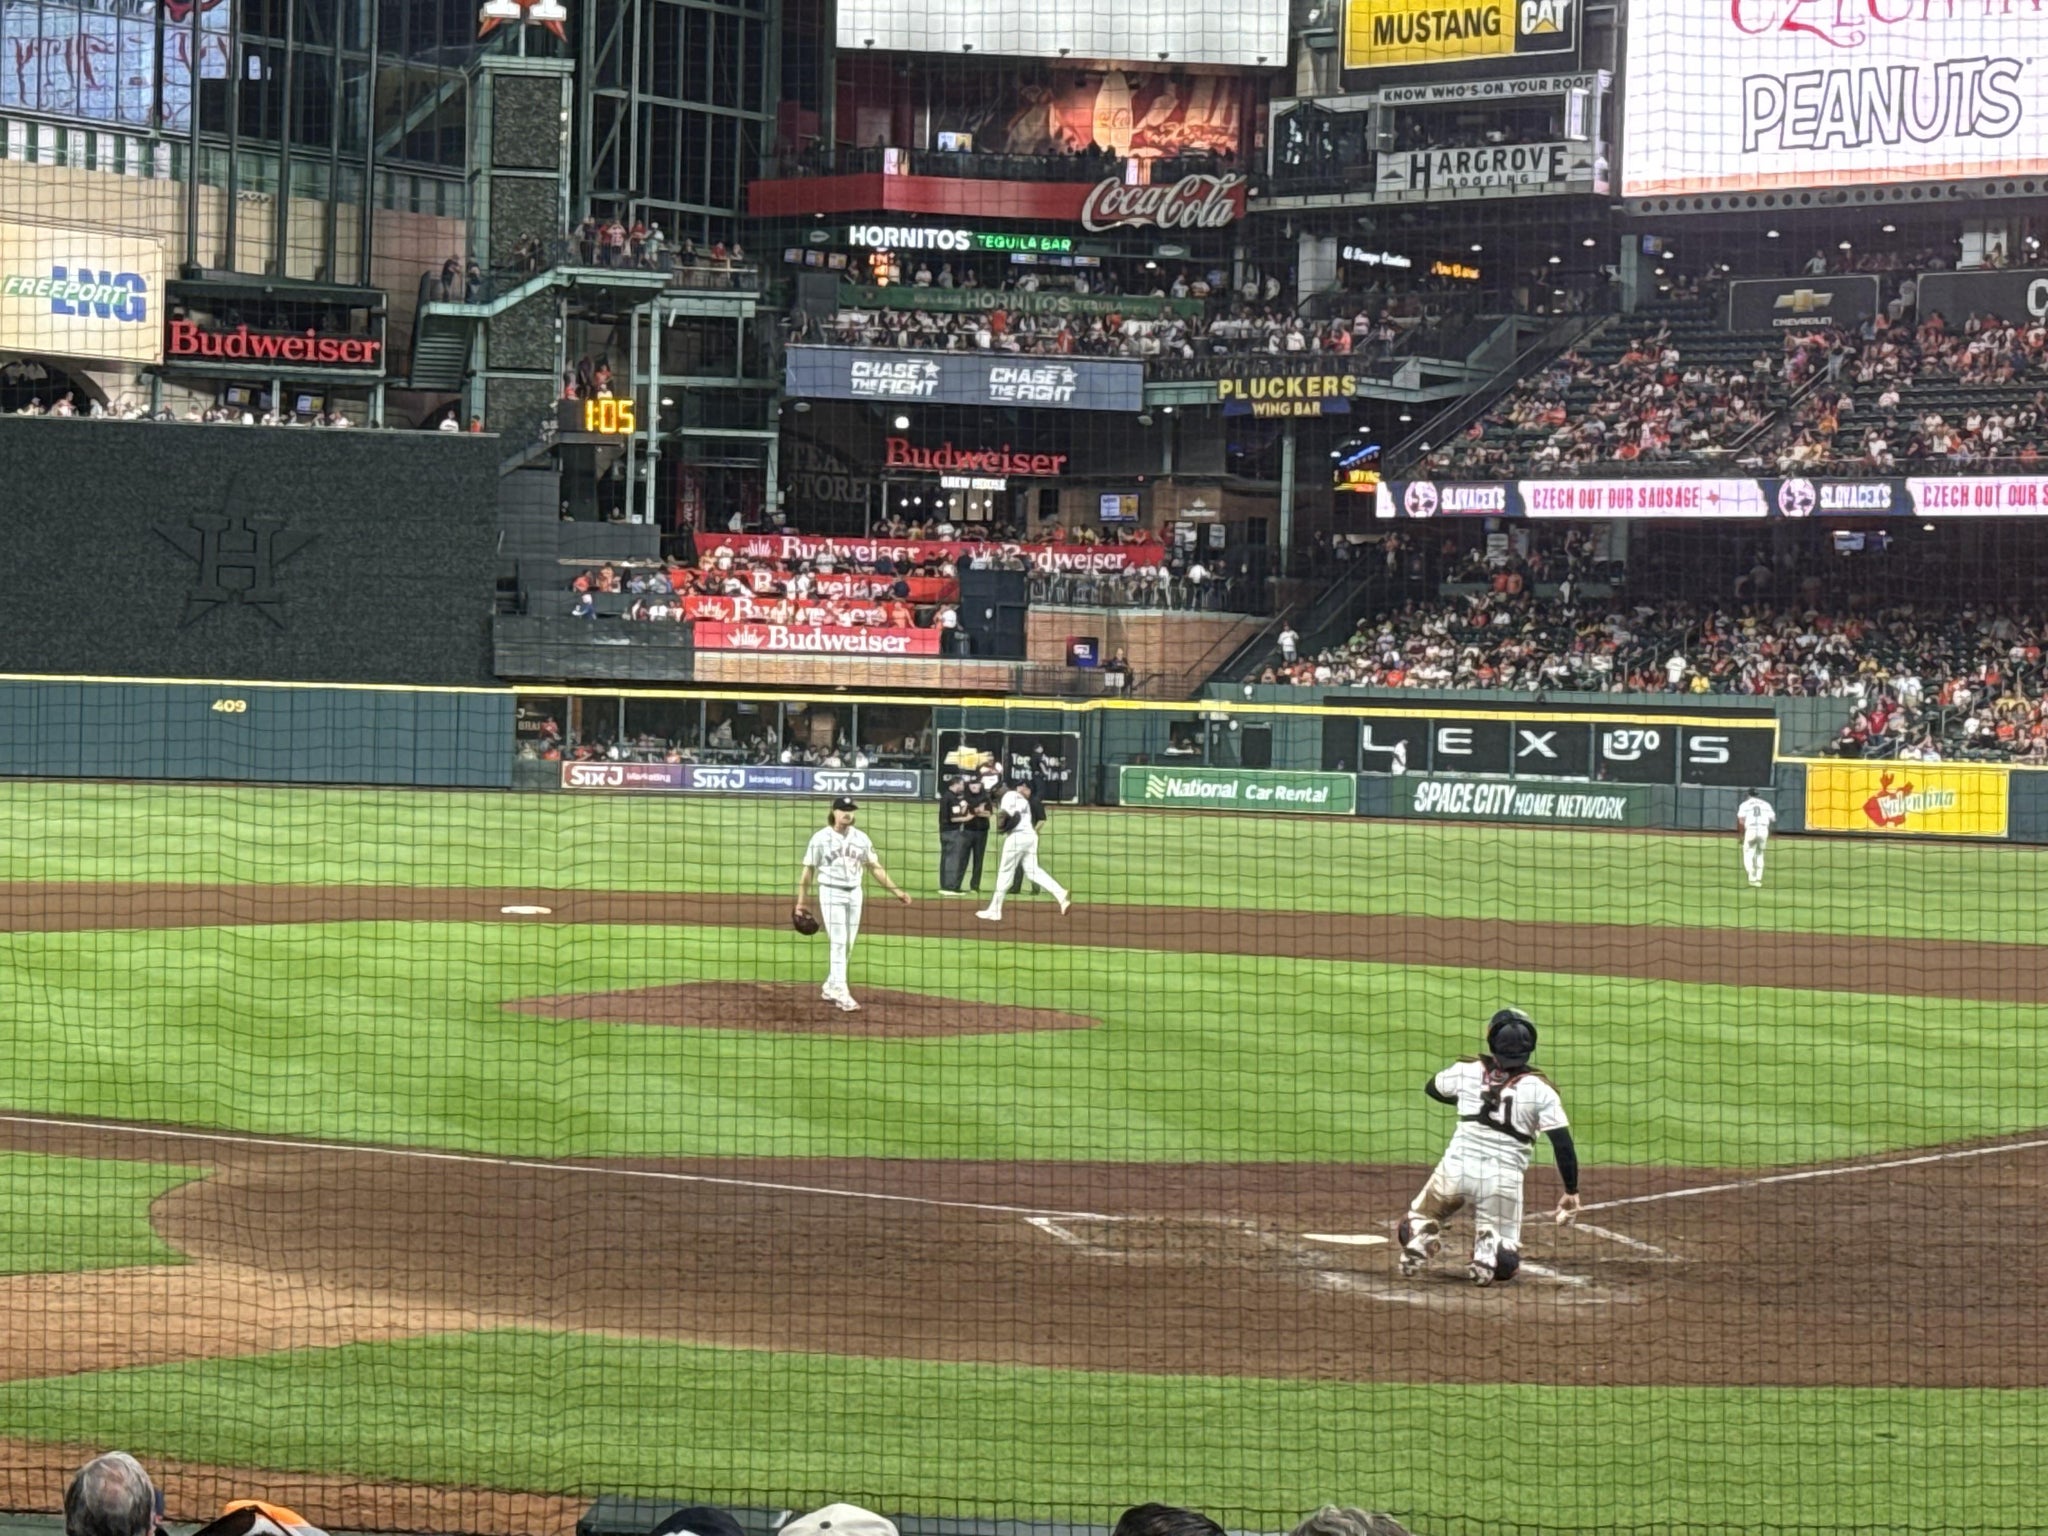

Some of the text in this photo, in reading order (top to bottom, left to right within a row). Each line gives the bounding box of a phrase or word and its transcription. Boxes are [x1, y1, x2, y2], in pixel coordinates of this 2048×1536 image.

[1373, 6, 1501, 46] MUSTANG
[1520, 0, 1567, 34] CAT
[1383, 76, 1594, 102] KNOW WHO'S ON YOUR ROOF
[1743, 55, 2023, 153] PEANUTS
[1409, 145, 1568, 189] HARGROVE
[1082, 173, 1248, 232] Coca-Cola
[850, 226, 1072, 251] HORNITOS TEQUILA BAR
[5, 277, 127, 305] FREEPORT
[52, 266, 147, 322] LNG
[967, 291, 1071, 312] HORNITOS
[168, 320, 381, 364] Budweiser
[851, 361, 921, 379] CHASE
[990, 367, 1059, 384] CHASE
[851, 378, 938, 396] THE FIGHT
[990, 384, 1076, 401] THE FIGHT
[1218, 375, 1356, 400] PLUCKERS
[586, 400, 635, 434] 1:05
[1252, 401, 1321, 416] WING BAR
[885, 436, 1067, 475] Budweiser
[1533, 488, 1574, 509] CZECH
[1579, 488, 1605, 509] OUT
[1639, 486, 1700, 509] SAUSAGE
[1923, 485, 1970, 507] CZECH
[1975, 485, 2002, 508] OUT
[2009, 484, 2037, 506] OUR
[768, 625, 911, 652] Budweiser
[212, 699, 247, 712] 409
[1613, 730, 1660, 750] 370
[1167, 777, 1329, 804] National Car Rental
[1414, 781, 1627, 821] SPACE CITY HOME NETWORK
